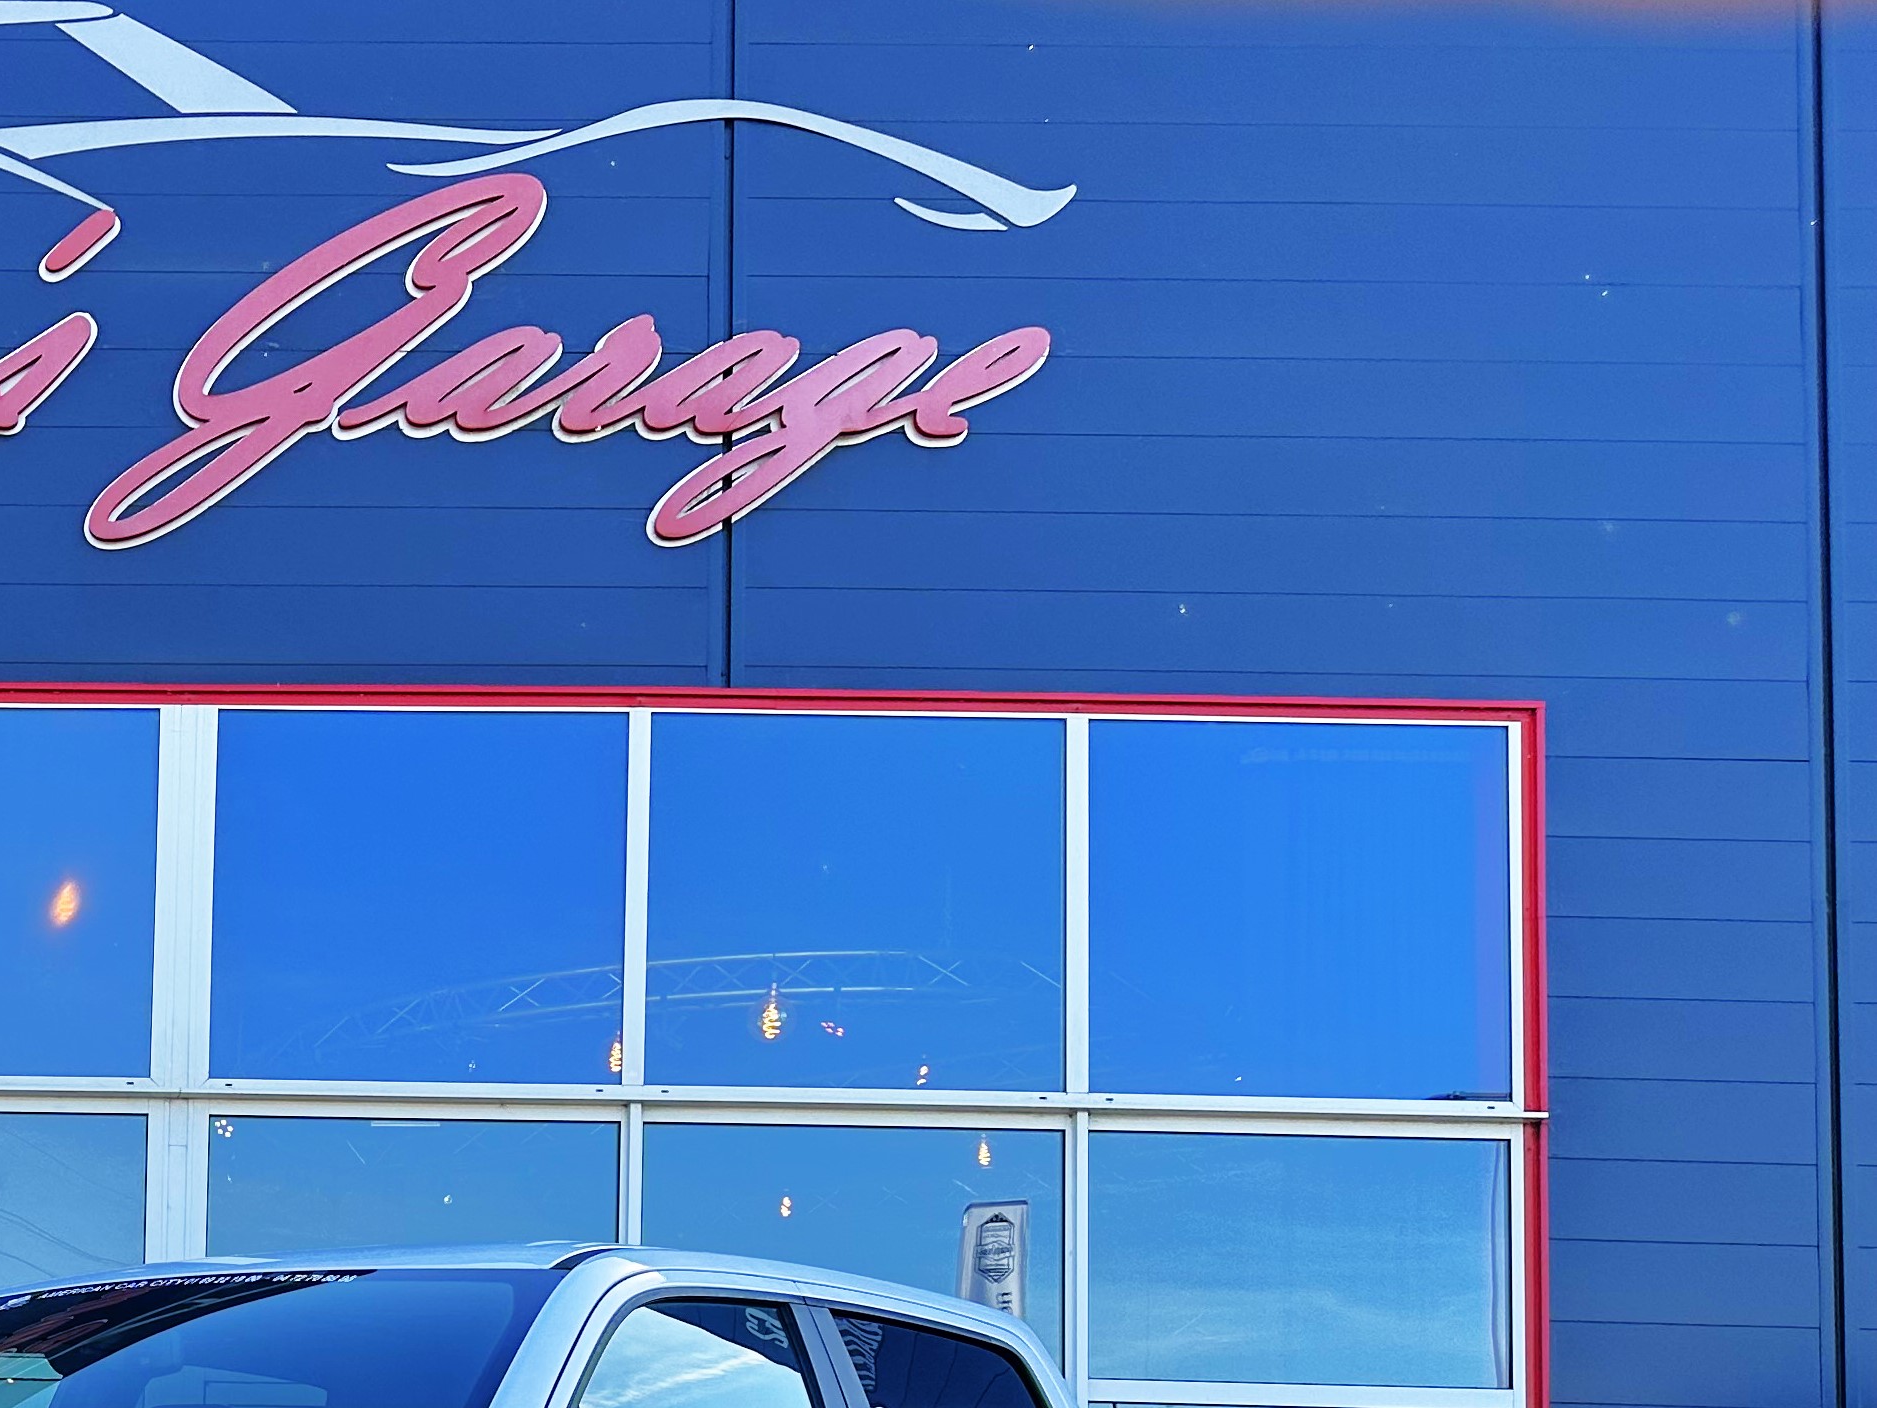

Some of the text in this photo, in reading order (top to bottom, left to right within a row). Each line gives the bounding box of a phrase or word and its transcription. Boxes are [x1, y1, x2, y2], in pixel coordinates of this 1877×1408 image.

[85, 172, 1052, 550] Garage
[115, 1280, 149, 1290] CAR
[149, 1277, 184, 1287] CITY
